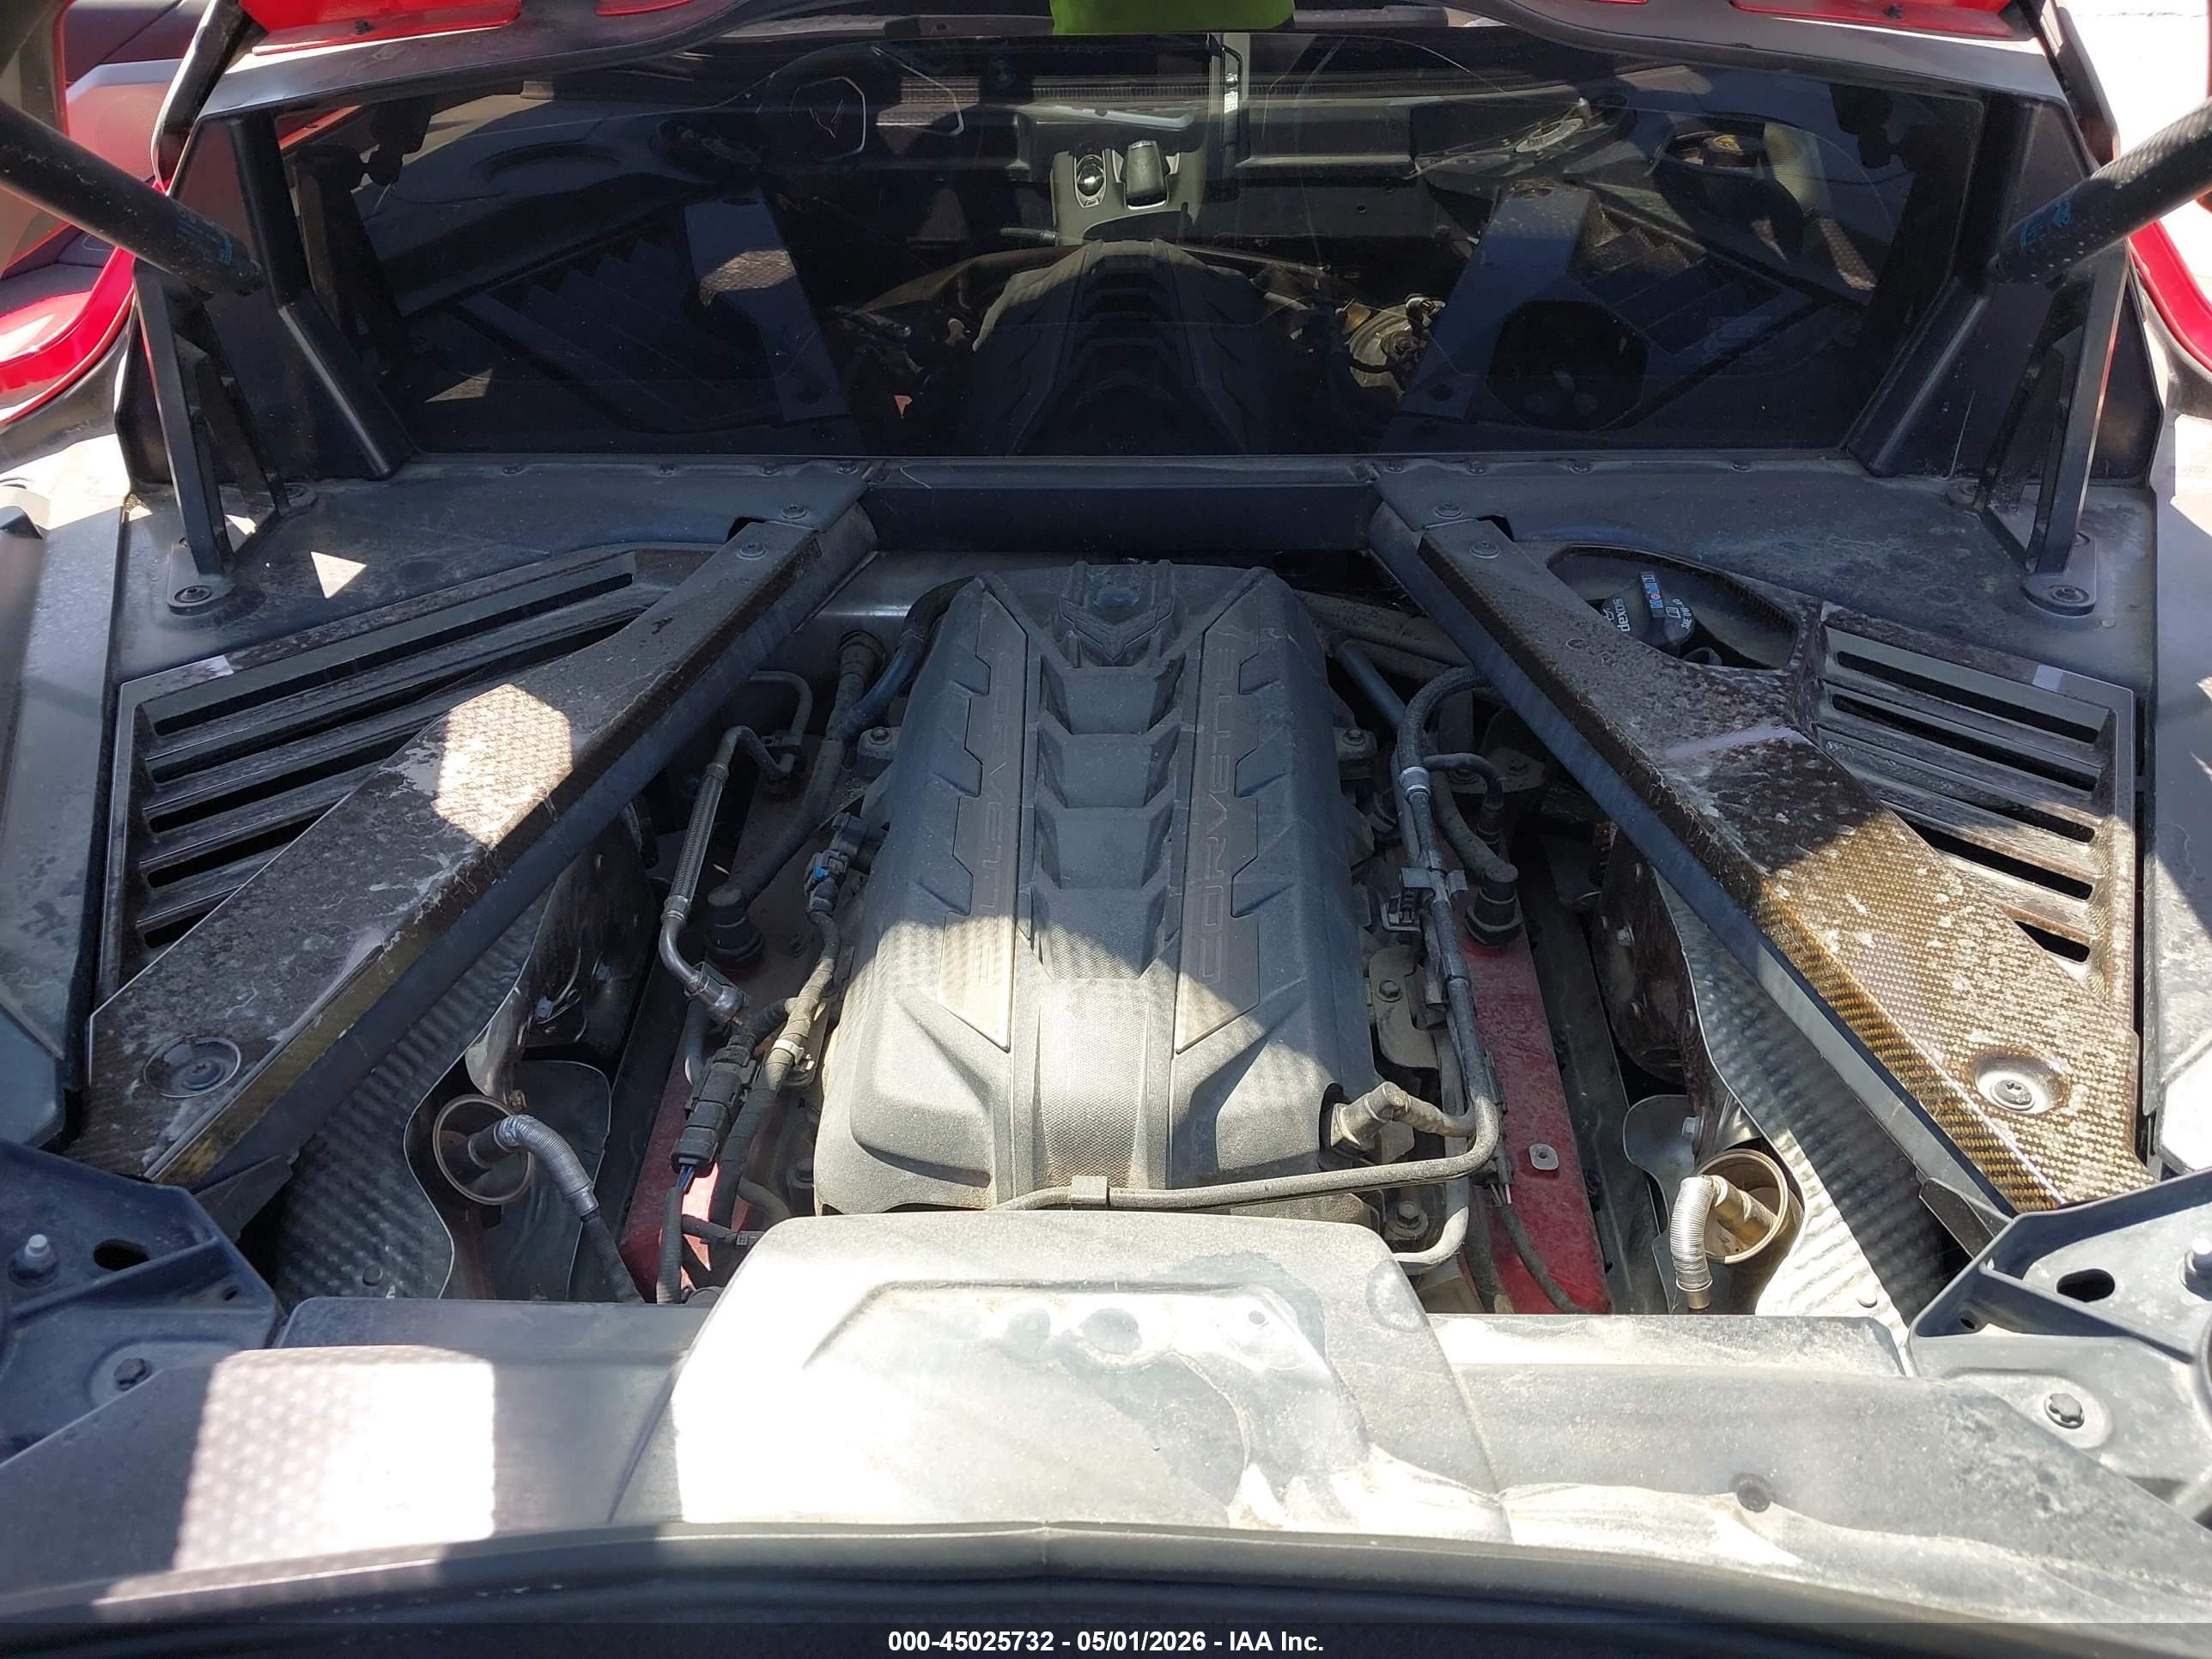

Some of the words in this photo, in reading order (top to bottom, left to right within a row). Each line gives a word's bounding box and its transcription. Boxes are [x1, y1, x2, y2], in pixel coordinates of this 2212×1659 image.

[1613, 599, 1631, 632] dexos
[1681, 617, 1692, 629] SAE
[1199, 647, 1237, 983] CORVETTE
